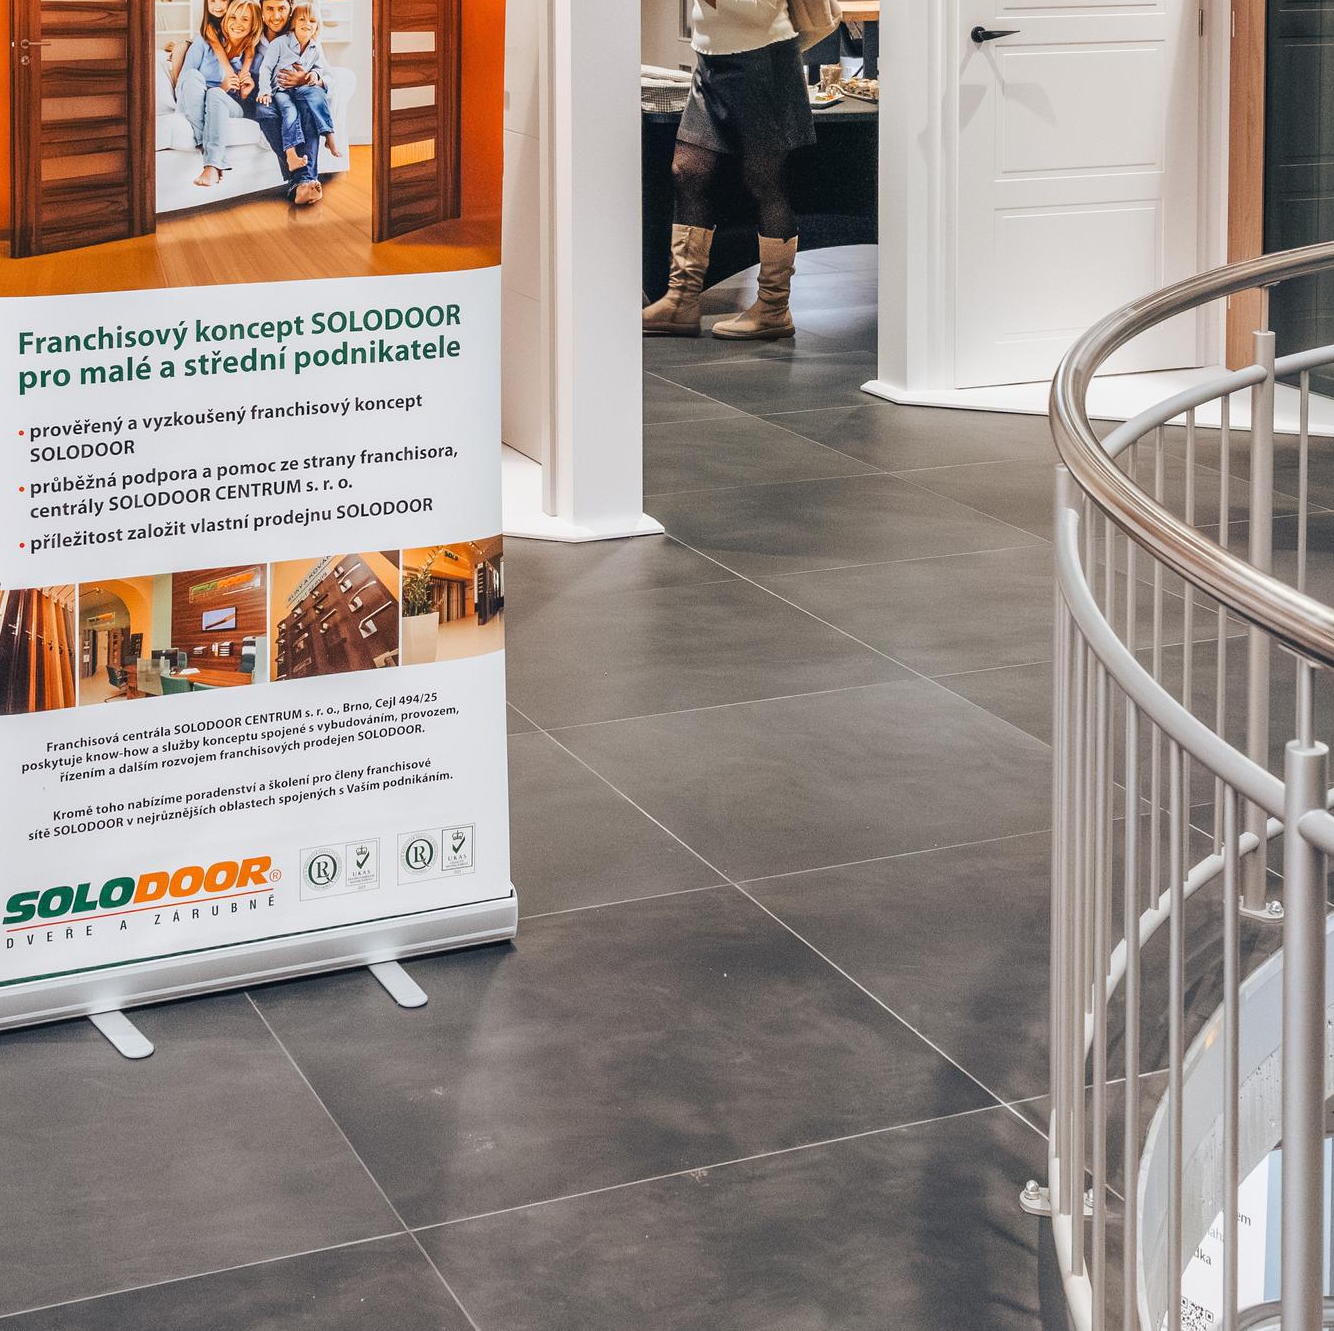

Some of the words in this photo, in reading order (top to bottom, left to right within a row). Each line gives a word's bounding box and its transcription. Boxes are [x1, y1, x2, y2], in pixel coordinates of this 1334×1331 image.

[19, 320, 189, 355] Franchisový
[195, 315, 305, 344] koncept
[311, 303, 461, 335] SOLODOOR
[19, 368, 71, 396] pro
[80, 355, 152, 386] malé
[159, 360, 175, 379] a
[184, 341, 287, 377] střední
[294, 334, 461, 375] podnikatele
[30, 415, 124, 443] prověřený
[127, 418, 138, 431] a
[142, 405, 247, 432] vyzkoušený
[250, 397, 351, 420] franchisový
[355, 394, 423, 412] koncept
[30, 439, 135, 463] SOLODOOR
[30, 471, 117, 499] průběžná
[122, 467, 198, 490] podpora
[202, 467, 212, 479] a
[217, 461, 277, 481] pomoc
[280, 459, 299, 472] ze
[303, 454, 357, 470] strany
[359, 445, 458, 464] franchisora,
[30, 498, 105, 519] centrály
[109, 487, 211, 512] SOLODOOR
[215, 478, 301, 501] CENTRUM
[305, 481, 319, 492] s.
[323, 479, 334, 491] r.
[337, 478, 353, 490] o.
[30, 528, 123, 555] příležitost
[127, 520, 186, 541] založit
[190, 513, 249, 534] vlastní
[253, 508, 332, 532] prodejnu
[336, 497, 433, 520] SOLODOOR
[21, 754, 83, 775] poskytuje
[85, 746, 150, 763] know-how
[151, 745, 159, 754] a
[161, 738, 200, 753] služby
[202, 732, 258, 747] konceptu
[261, 723, 307, 742] spojené
[308, 724, 315, 733] s
[316, 712, 398, 734] vybudováním,
[400, 706, 459, 723] provozem,
[46, 732, 120, 753] Franchisová
[122, 726, 171, 742] centrála
[173, 716, 242, 736] SOLODOOR
[244, 708, 303, 726] CENTRUM
[305, 710, 314, 718] s.
[316, 708, 324, 716] r.
[326, 706, 340, 715] o.,
[343, 702, 373, 713] Brno,
[375, 696, 396, 710] Cejl
[398, 692, 438, 705] 494/25
[59, 767, 106, 783] řízením
[108, 767, 116, 776] a
[118, 760, 159, 774] dalším
[161, 752, 217, 768] rozvojem
[219, 740, 301, 760] franchisových
[303, 734, 355, 751] prodejen
[357, 723, 425, 742] SOLODOOR.
[28, 828, 51, 841] sítě
[53, 817, 124, 837] SOLODOOR
[126, 817, 134, 826] v
[136, 804, 216, 826] nejrůznějších
[219, 795, 276, 813] oblastech
[278, 786, 336, 806] spojených
[339, 787, 345, 796] s
[346, 780, 380, 794] Vašim
[382, 771, 453, 791] podnikáním.
[53, 805, 93, 822] Kromě
[95, 802, 125, 815] toho
[127, 794, 183, 810] nabízíme
[185, 782, 257, 804] poradenství
[259, 783, 266, 792] a
[268, 774, 310, 790] školení
[312, 774, 332, 786] pro
[334, 769, 365, 780] členy
[366, 757, 431, 776] franchisové
[2, 855, 272, 925] SOLODOOR
[6, 925, 92, 949] DVEŘE
[119, 920, 127, 930] A
[154, 895, 275, 925] ZÁRUBNĚ
